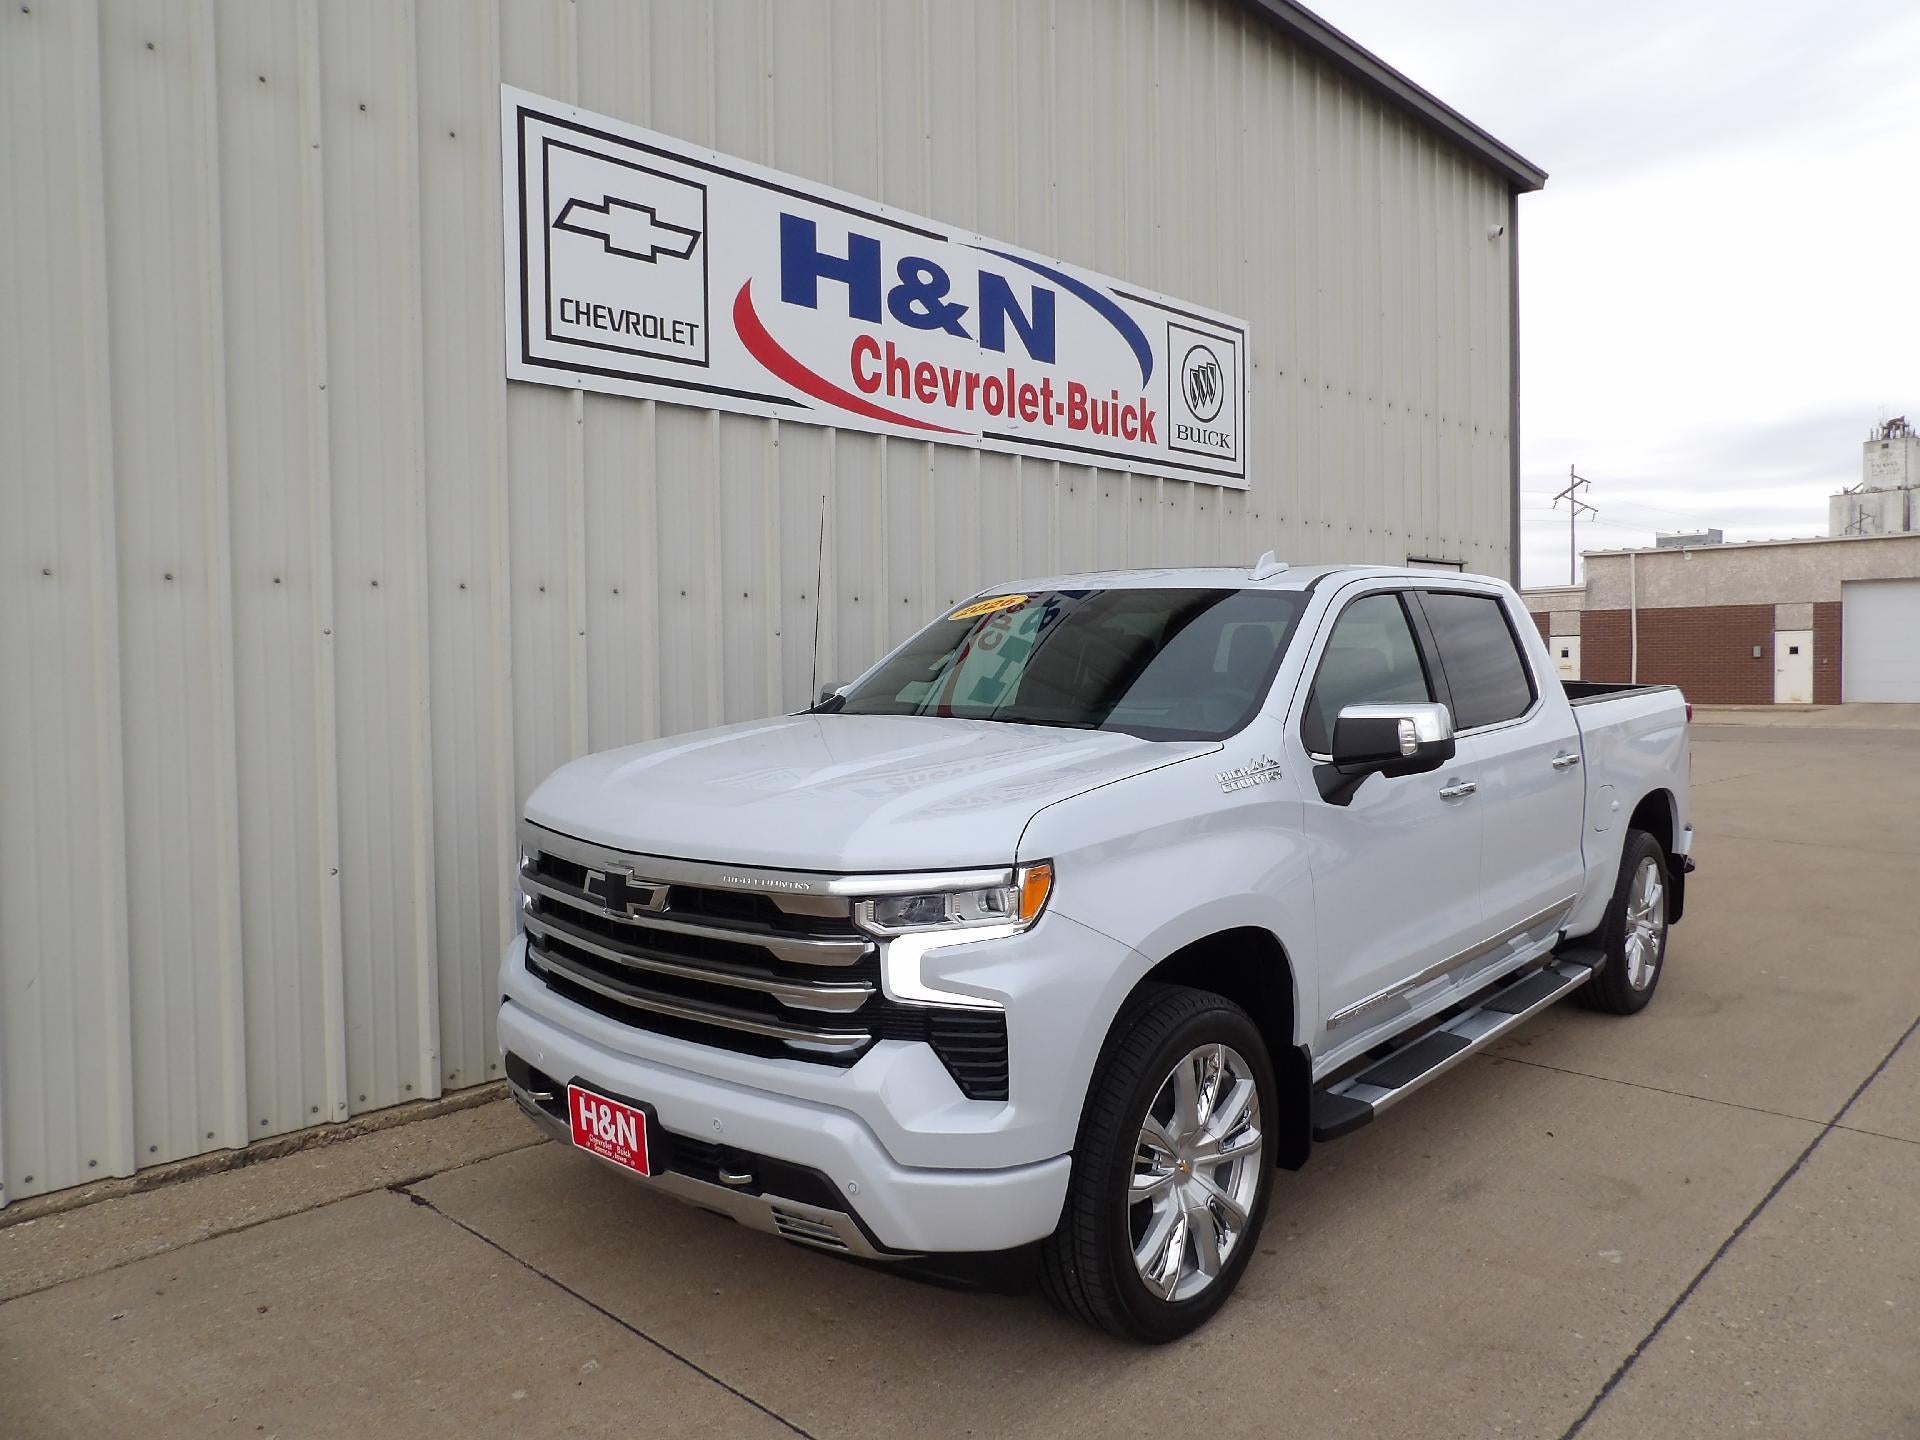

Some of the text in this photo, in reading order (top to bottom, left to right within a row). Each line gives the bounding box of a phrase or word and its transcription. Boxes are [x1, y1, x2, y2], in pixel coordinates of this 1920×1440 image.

[780, 212, 1056, 365] H&N
[560, 297, 699, 346] CHEVROLET
[850, 334, 1158, 445] Chevrolet-Buick
[1175, 423, 1231, 449] BUICK
[1221, 770, 1282, 793] COUNTRY
[579, 1096, 638, 1152] H&N
[616, 1145, 631, 1158] Buick
